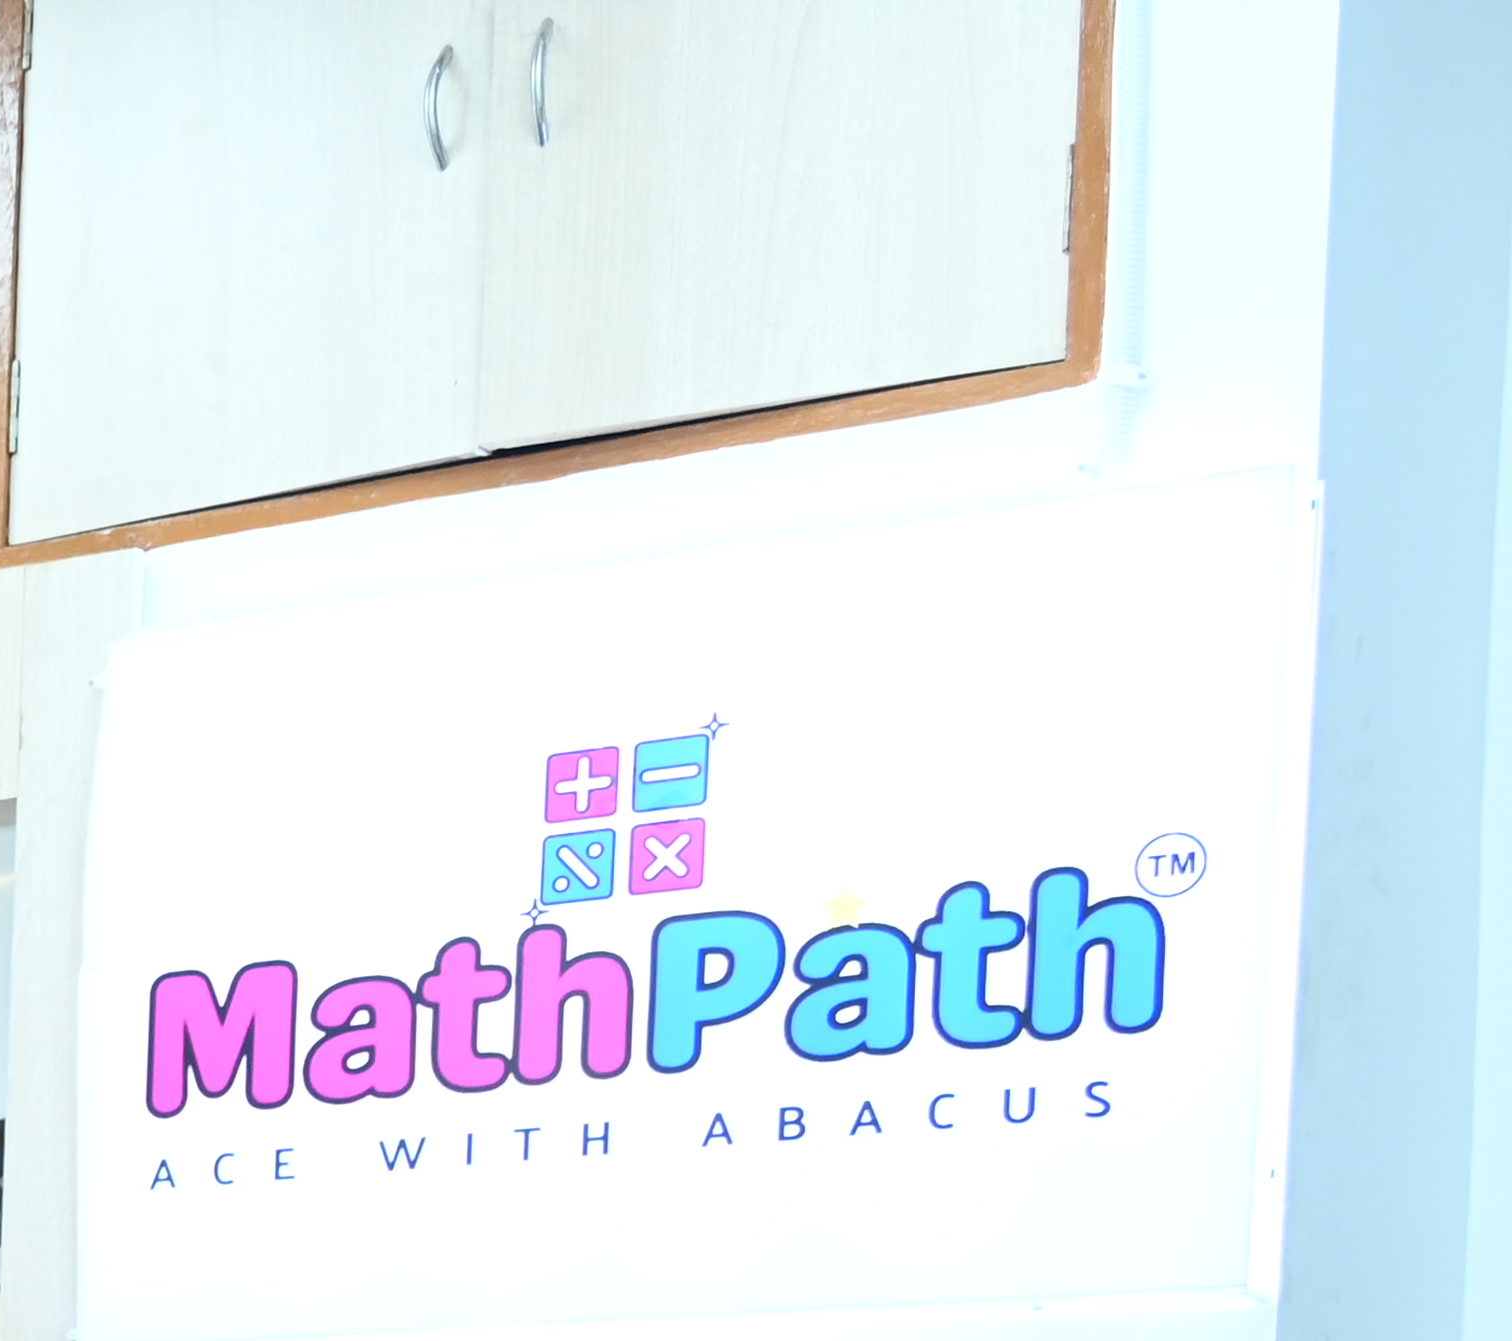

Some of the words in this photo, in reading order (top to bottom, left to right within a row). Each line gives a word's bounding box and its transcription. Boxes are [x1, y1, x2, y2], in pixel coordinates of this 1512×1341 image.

[1148, 852, 1196, 879] TM
[150, 1149, 296, 1191] ACE
[378, 1122, 611, 1172] WITH
[701, 1081, 1111, 1147] ABACUS
